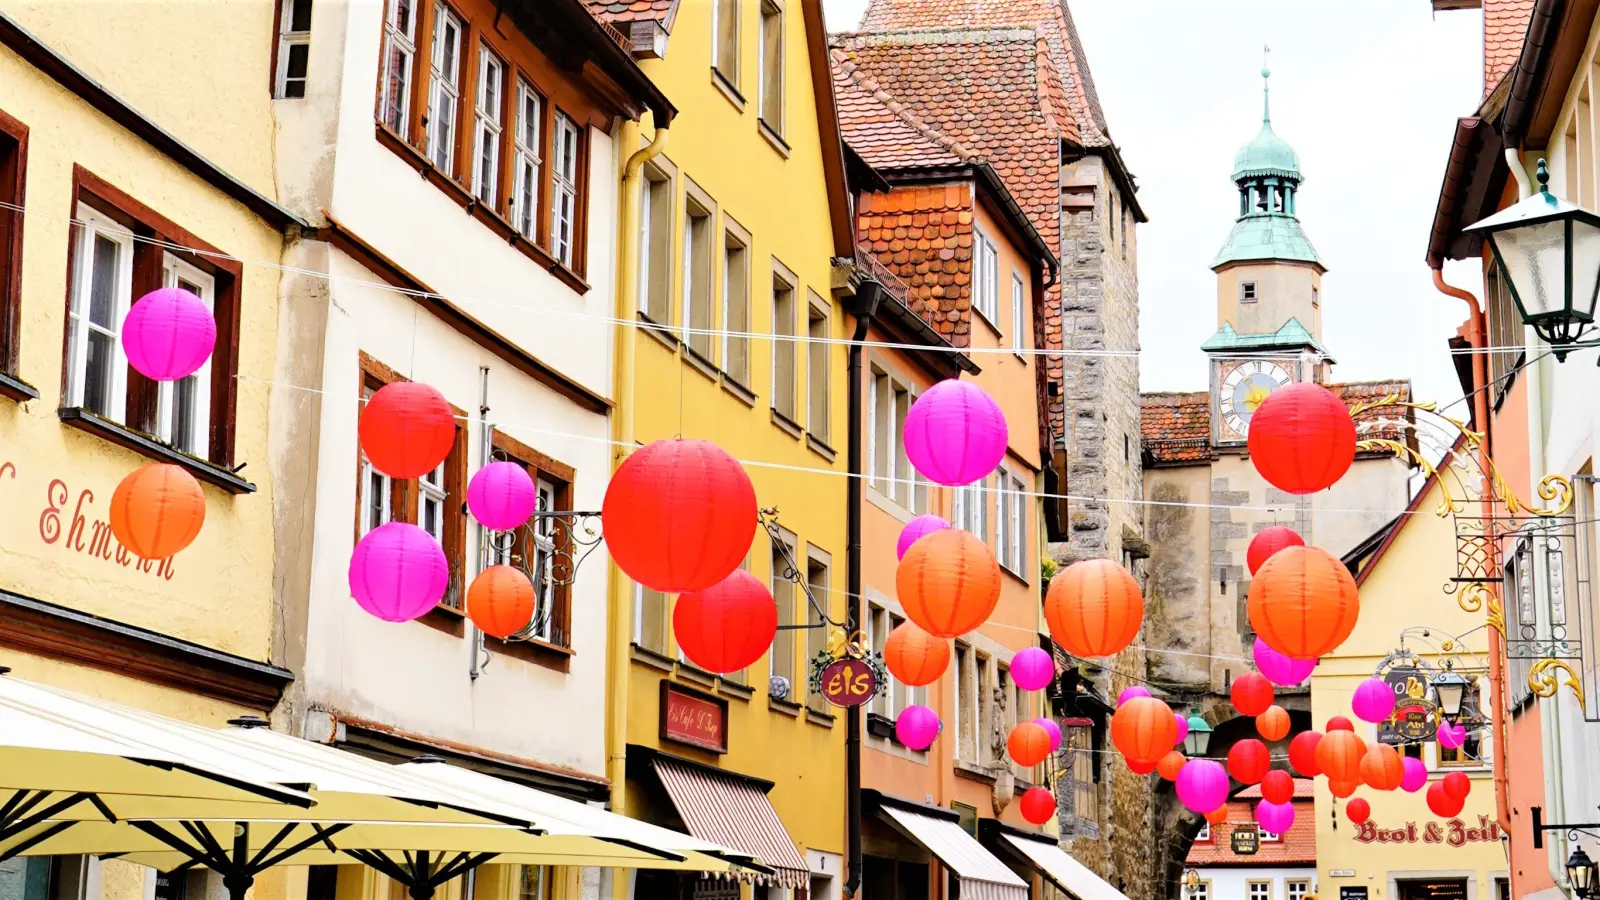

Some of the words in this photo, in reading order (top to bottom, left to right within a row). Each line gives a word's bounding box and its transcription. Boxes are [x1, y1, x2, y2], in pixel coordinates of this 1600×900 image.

[1353, 819, 1418, 844] Brot
[1422, 821, 1443, 844] &
[1446, 814, 1500, 848] Zeit
